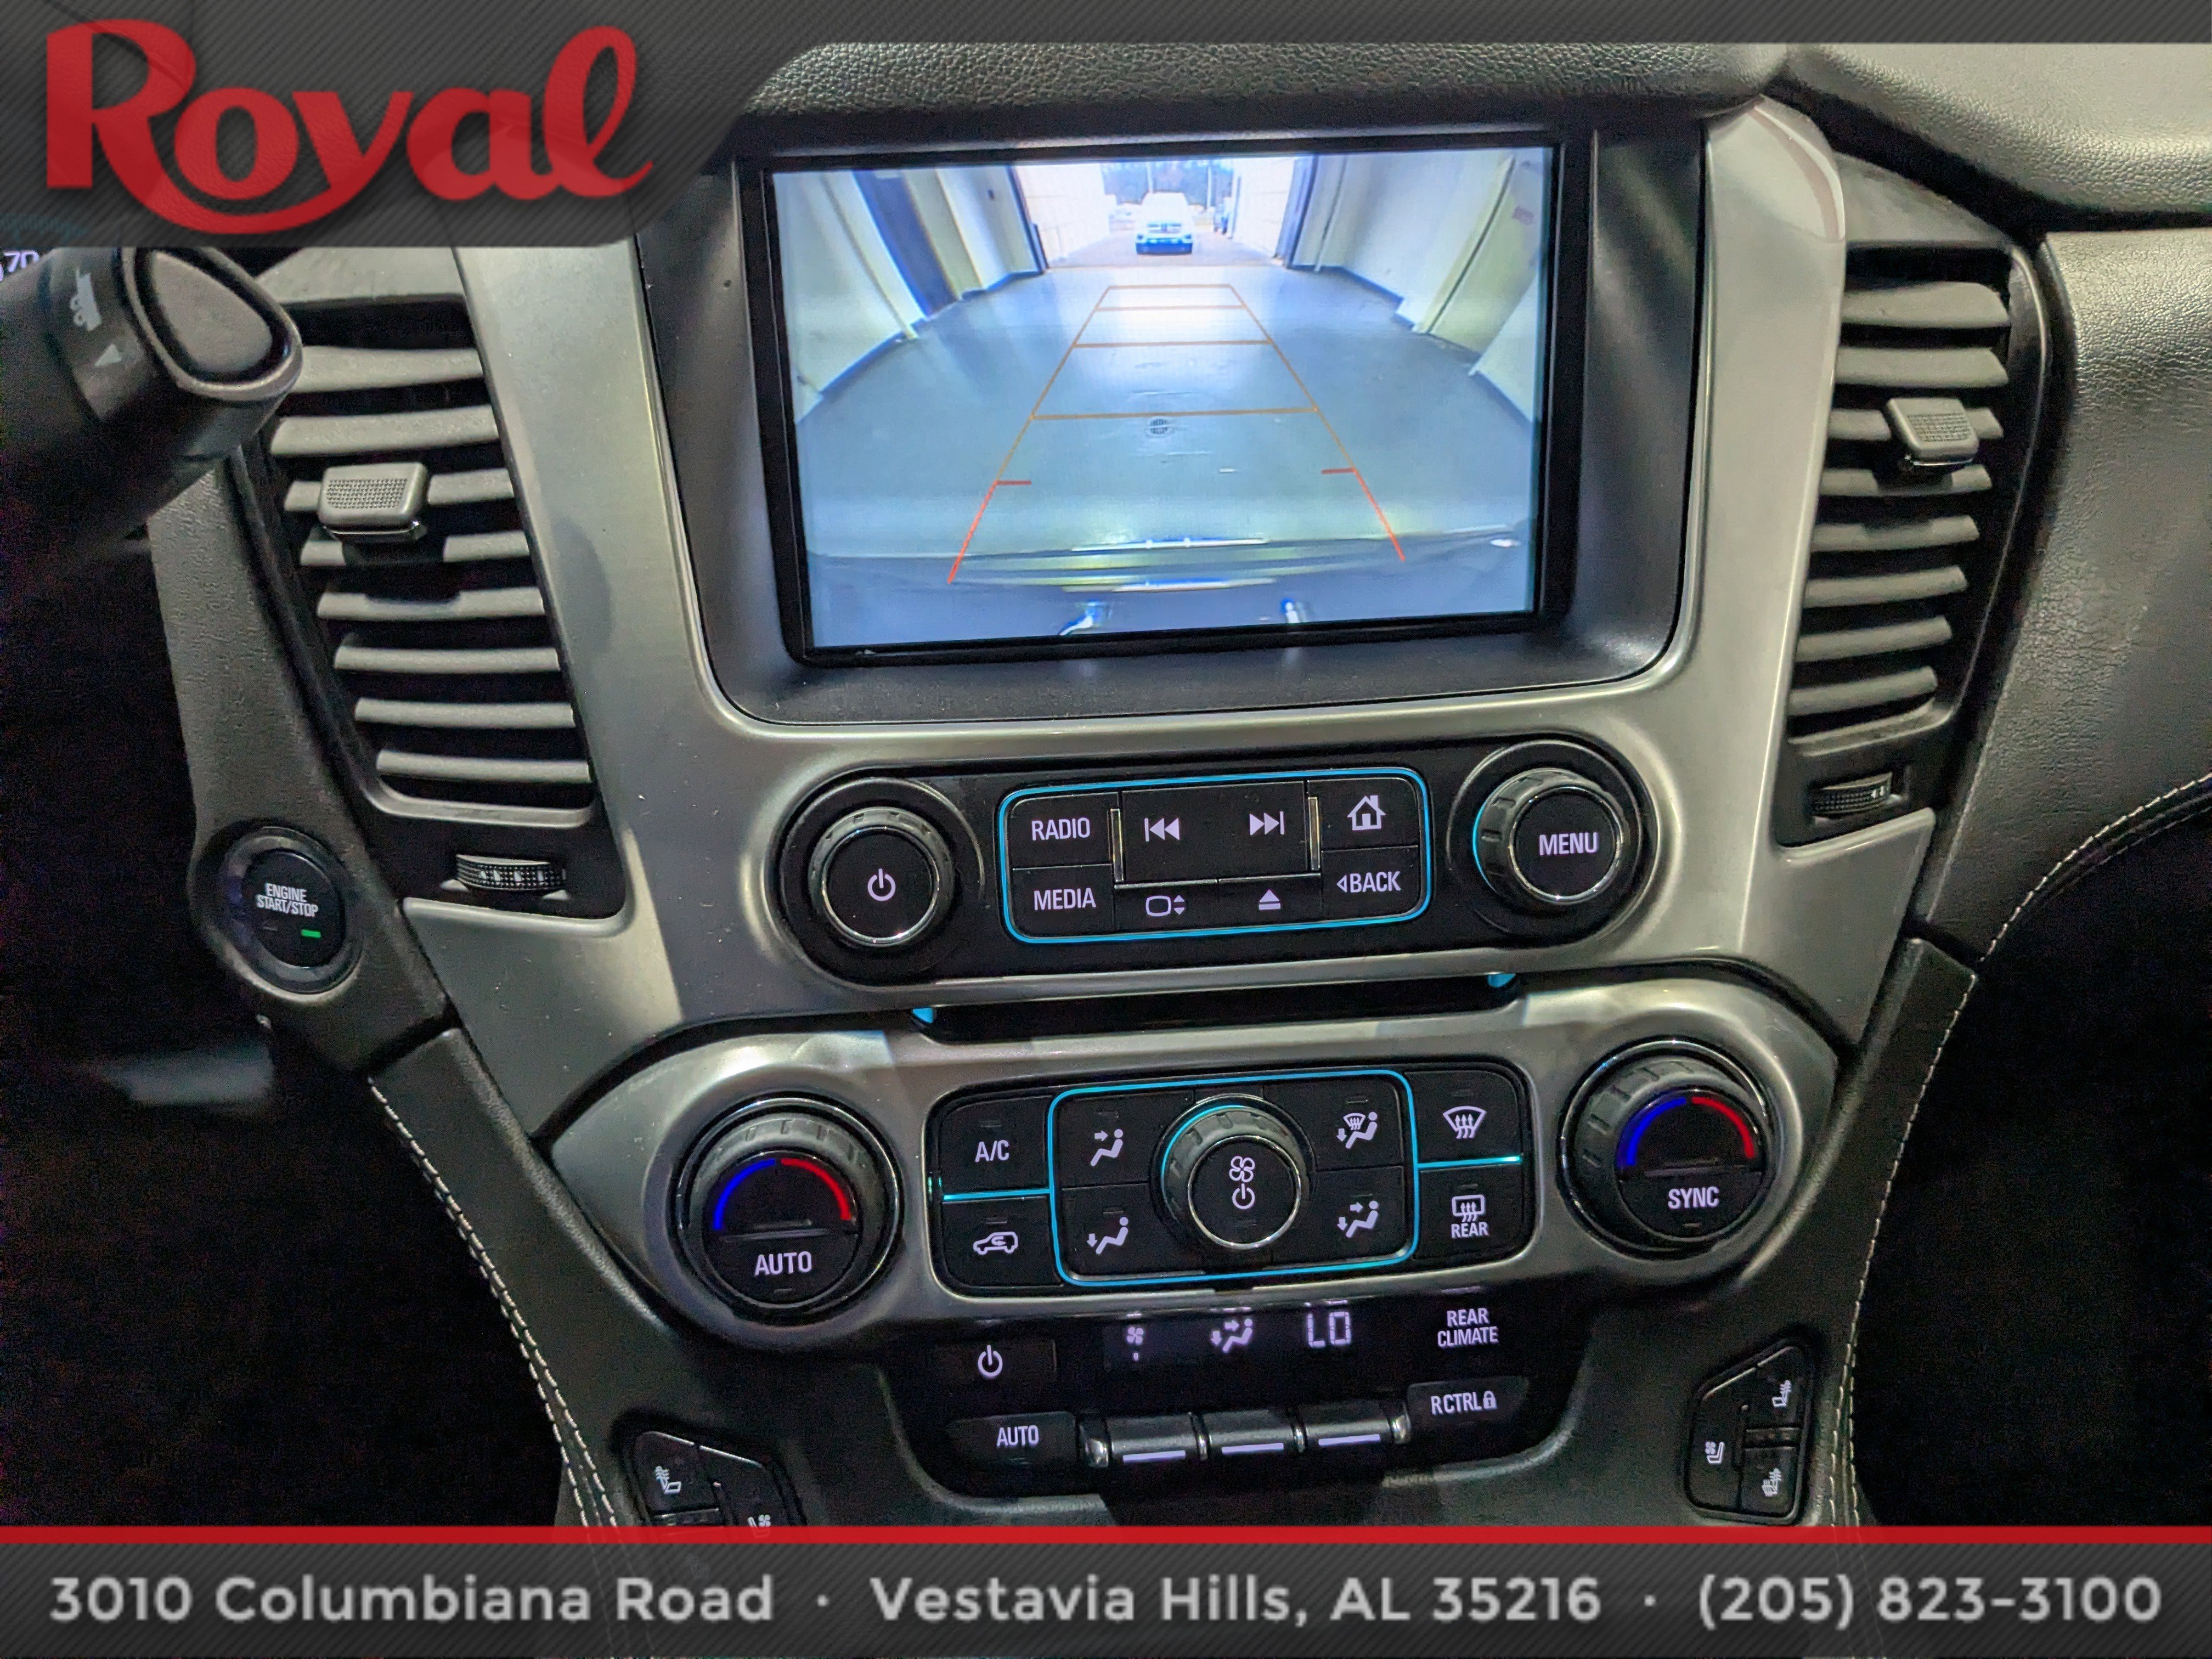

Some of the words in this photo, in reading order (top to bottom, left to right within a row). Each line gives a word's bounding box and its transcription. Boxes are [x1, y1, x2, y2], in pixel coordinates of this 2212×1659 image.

[1031, 817, 1091, 841] RADIO
[1539, 832, 1599, 856] MENU
[265, 883, 307, 902] ENGINE
[1350, 871, 1401, 893] BACK
[256, 894, 319, 917] START/STOP
[1034, 887, 1096, 911] MEDIA
[975, 1139, 1009, 1163] A/C
[1668, 1186, 1719, 1209] SYNC
[1451, 1221, 1489, 1238] REAR
[754, 1251, 812, 1277] AUTO
[1446, 1307, 1490, 1328] REAR
[1437, 1326, 1499, 1348] CLIMATE
[996, 1425, 1039, 1448] AUTO
